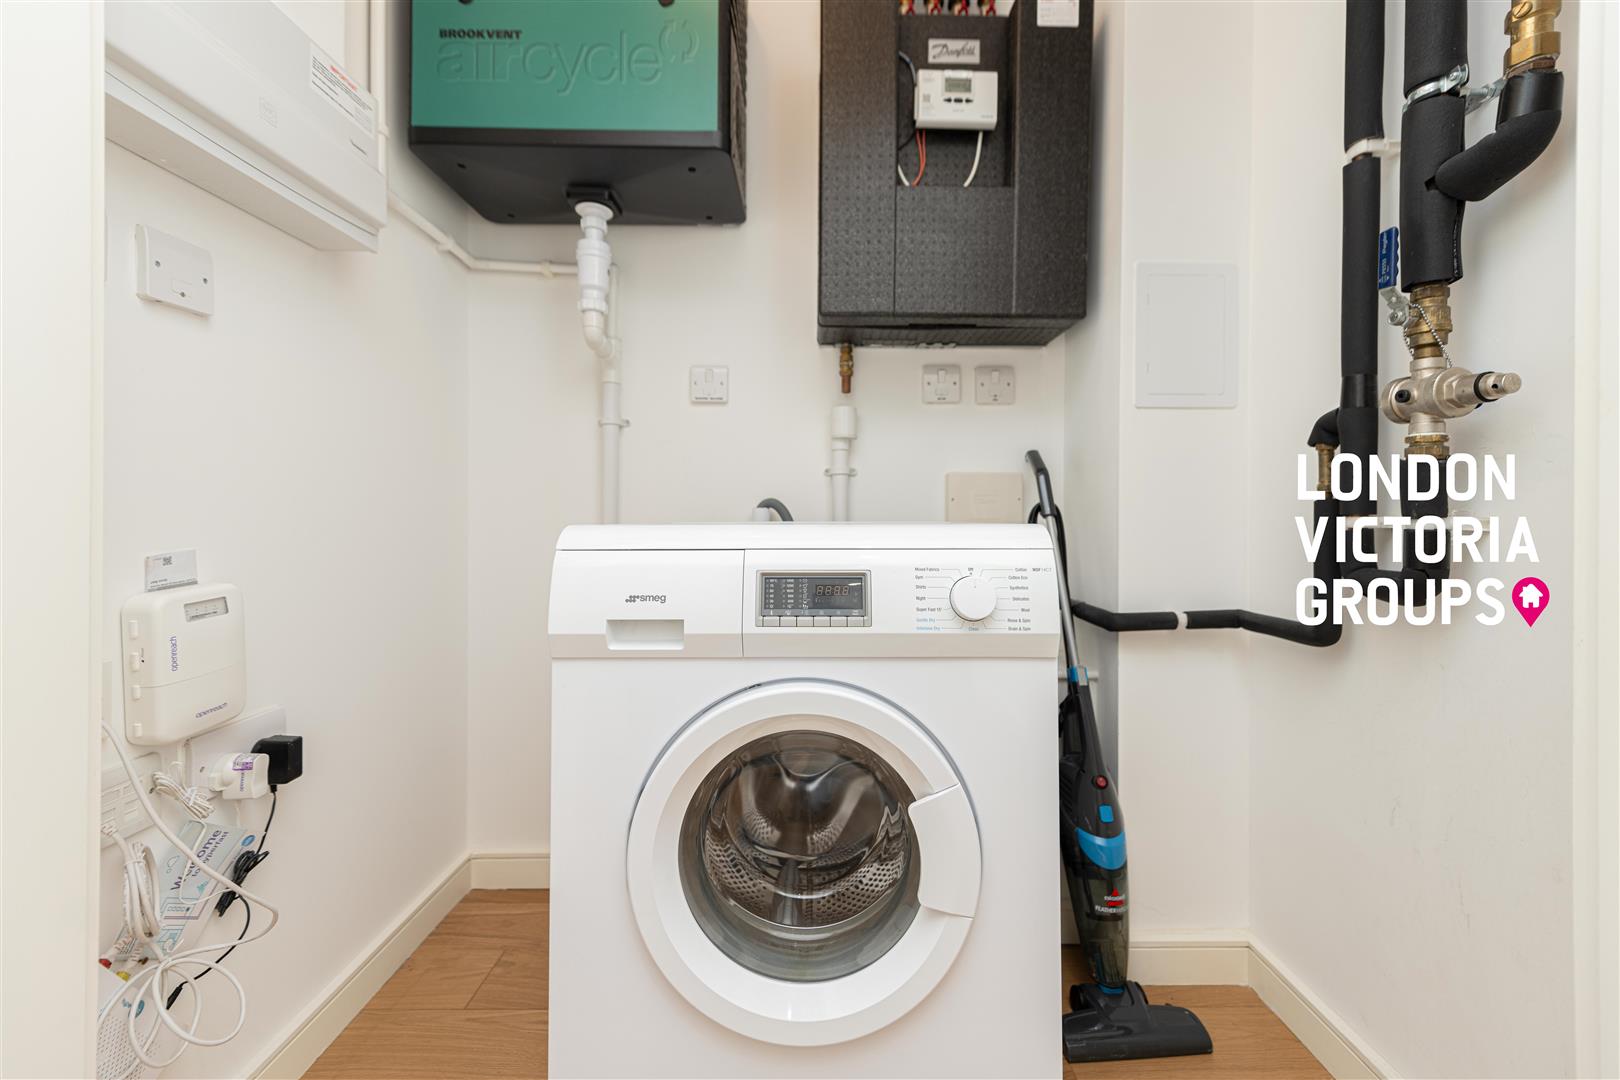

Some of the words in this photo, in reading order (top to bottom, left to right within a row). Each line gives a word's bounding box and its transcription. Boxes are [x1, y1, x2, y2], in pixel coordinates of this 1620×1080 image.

[437, 31, 661, 95] aircycle
[640, 594, 667, 604] smeg
[170, 636, 179, 672] openreach
